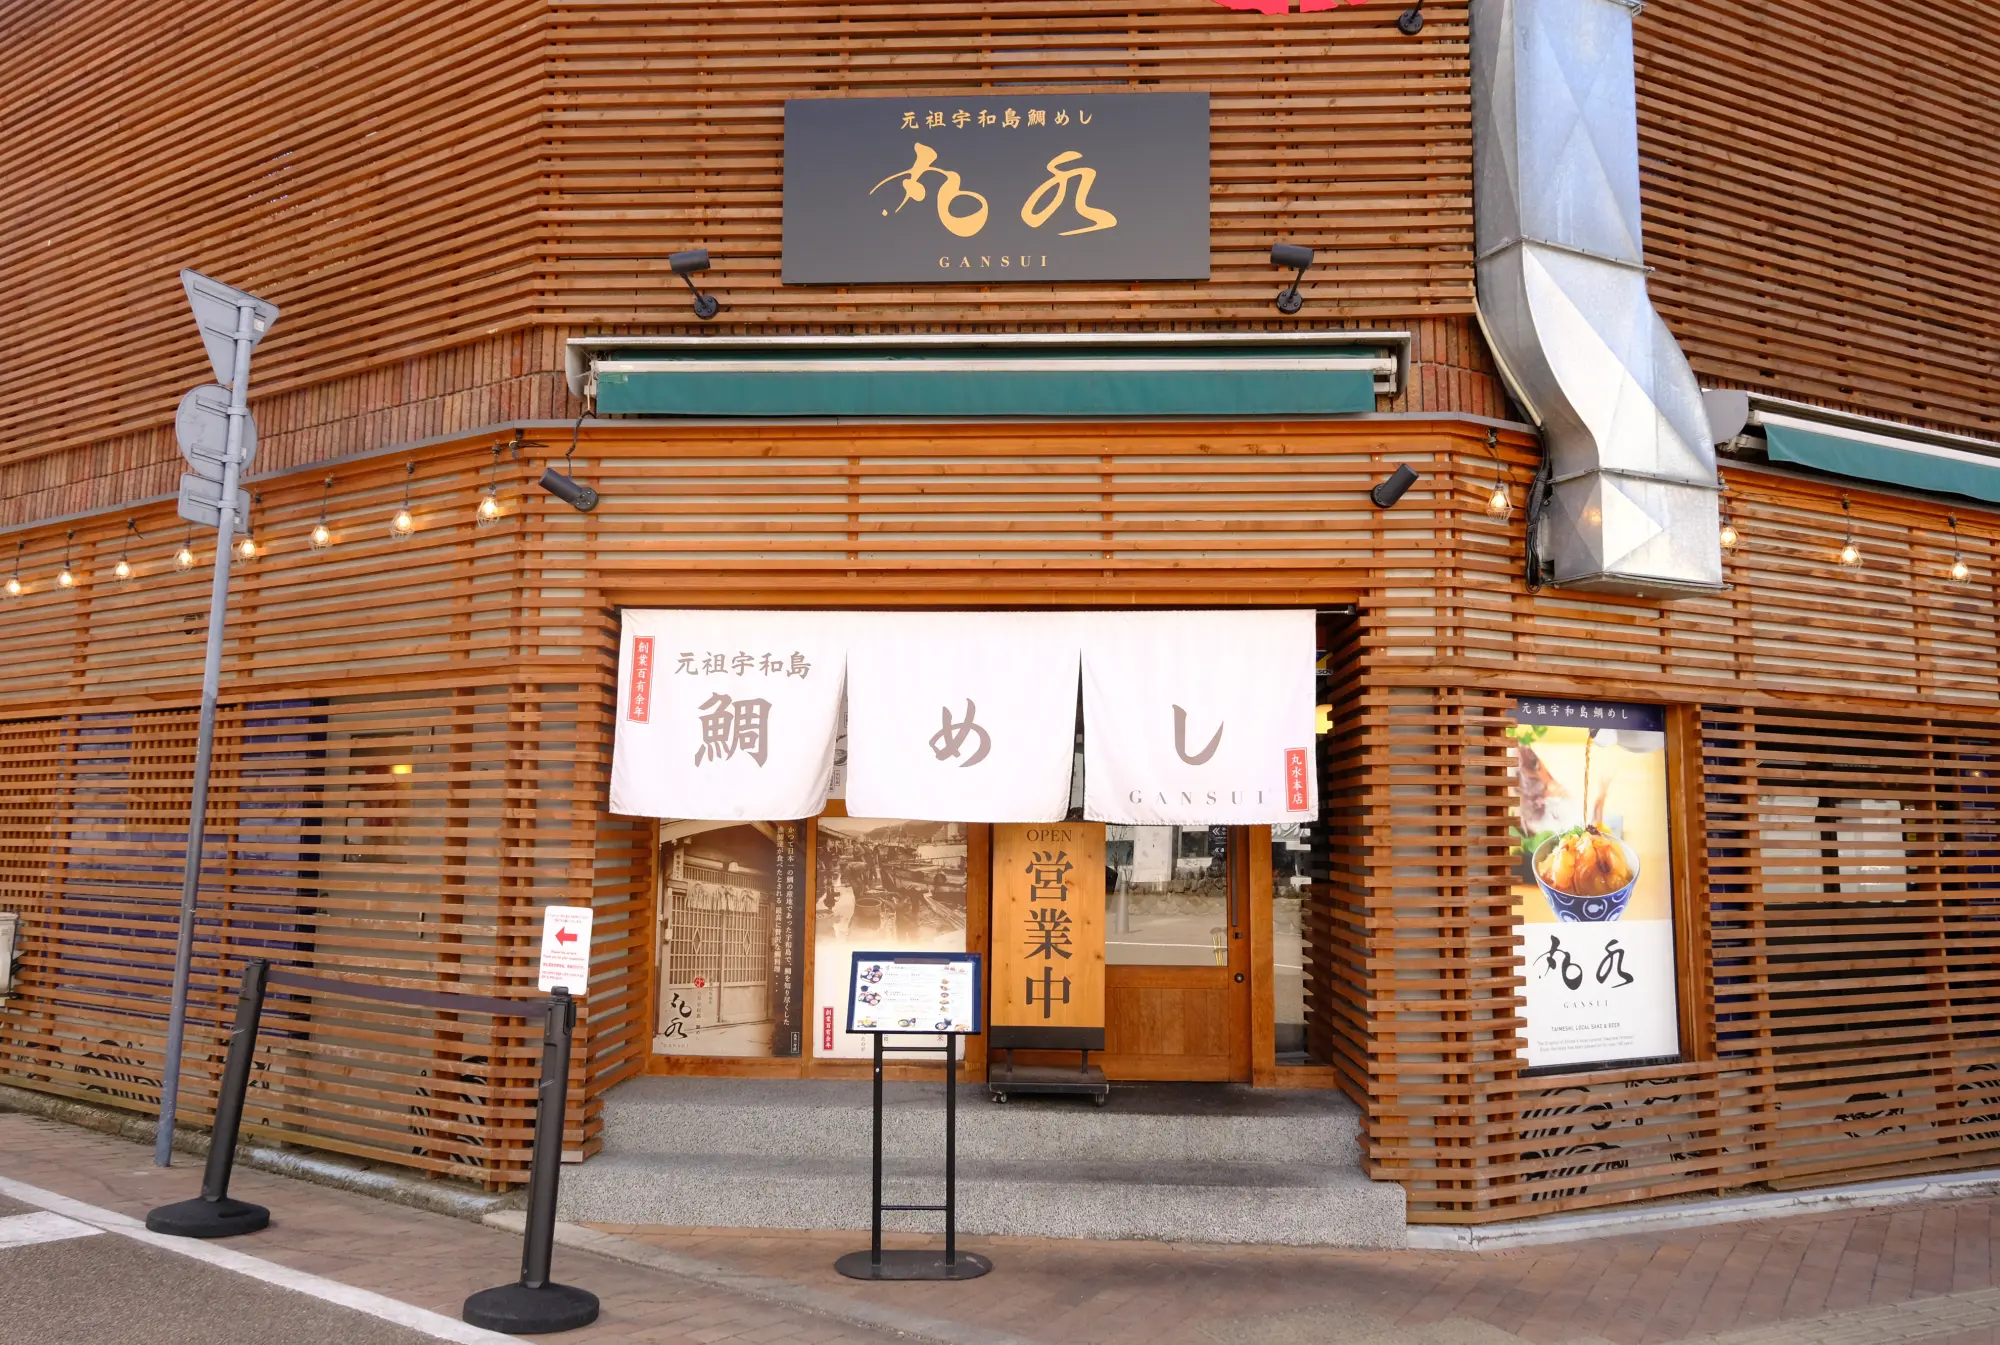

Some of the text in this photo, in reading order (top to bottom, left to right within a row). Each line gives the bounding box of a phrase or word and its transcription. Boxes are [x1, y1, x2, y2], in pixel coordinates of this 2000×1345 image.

[900, 107, 1093, 130] 元祖宇和島鯛めし
[938, 255, 1049, 269] GANSUI
[674, 650, 812, 680] 元祖宇和島
[633, 641, 650, 717] 創業百有余年
[1521, 702, 1628, 720] 元祖宇和島鯛めし
[1290, 753, 1304, 805] 丸水本店
[1129, 789, 1264, 806] GANSUI
[1026, 829, 1072, 842] OPEN
[1024, 850, 1074, 1019] 営業中
[1563, 1000, 1609, 1009] GANSUI
